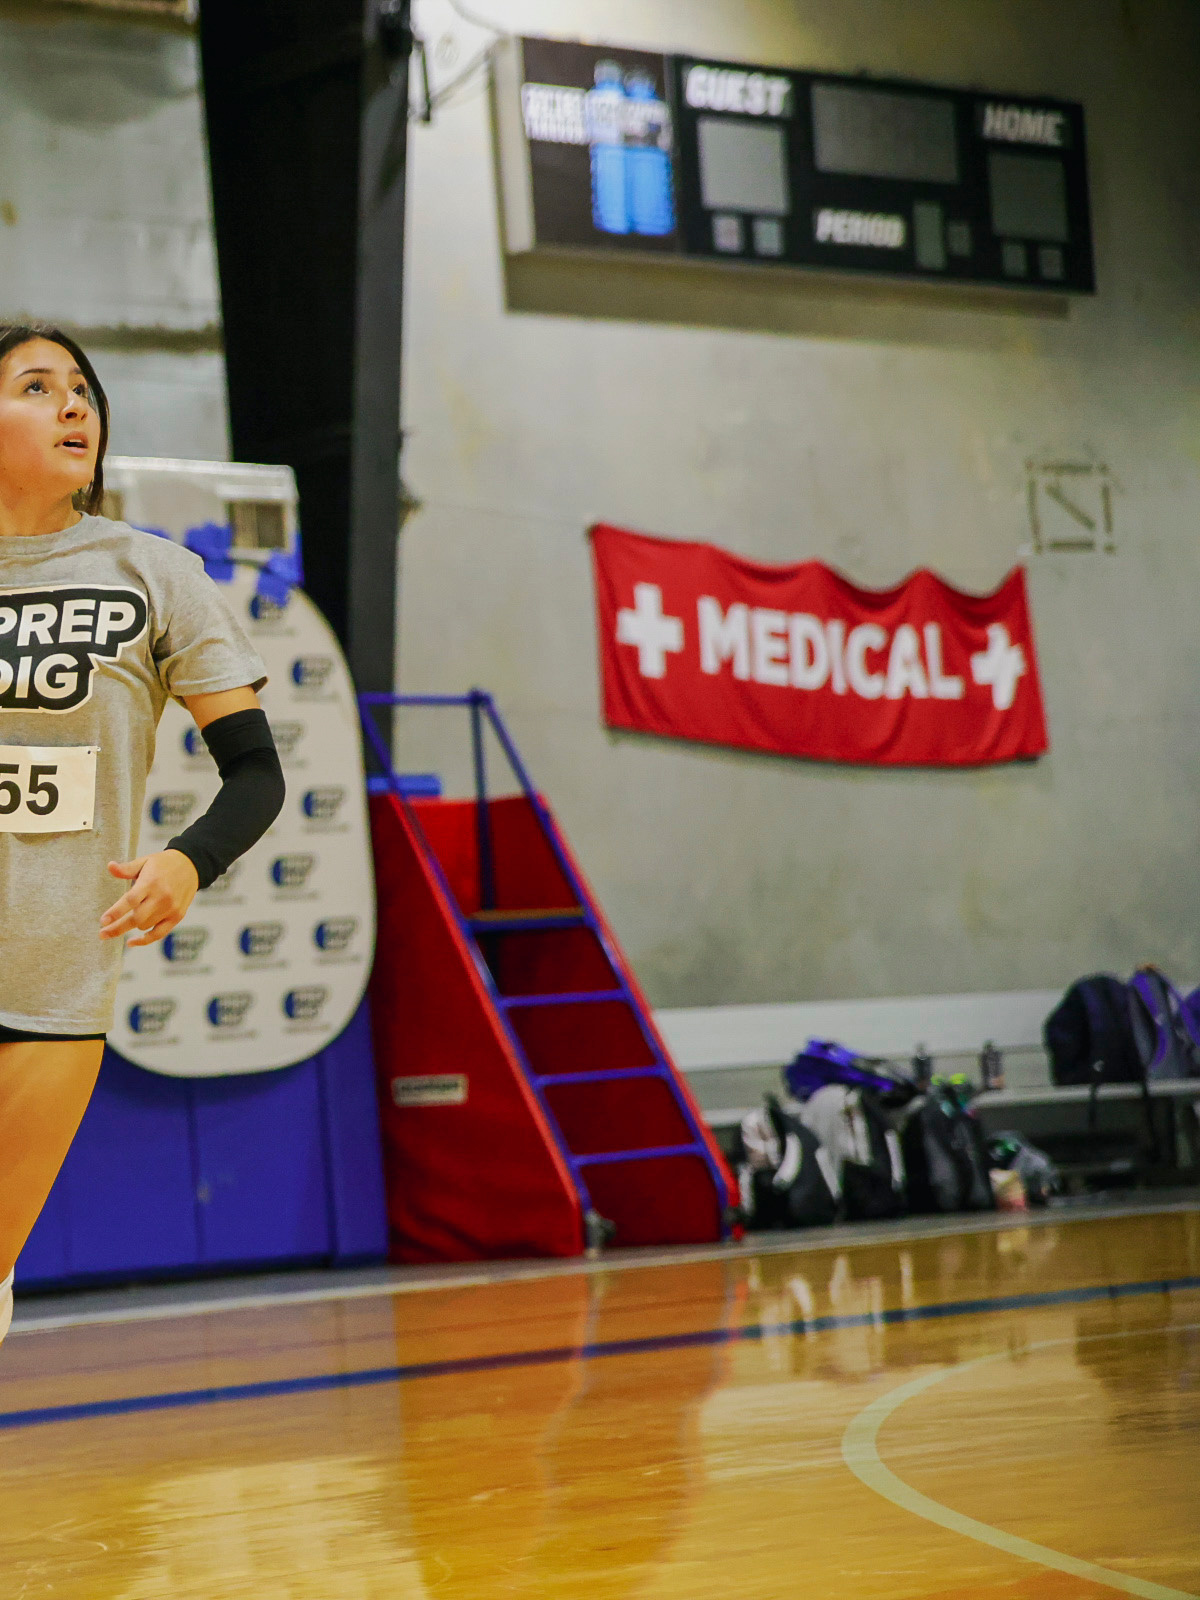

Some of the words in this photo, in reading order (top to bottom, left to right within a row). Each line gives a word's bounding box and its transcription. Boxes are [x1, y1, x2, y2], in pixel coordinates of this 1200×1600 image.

[684, 64, 791, 118] GUEST
[982, 103, 1065, 148] HOME
[814, 207, 905, 249] PERIOD
[697, 596, 964, 700] MEDICAL
